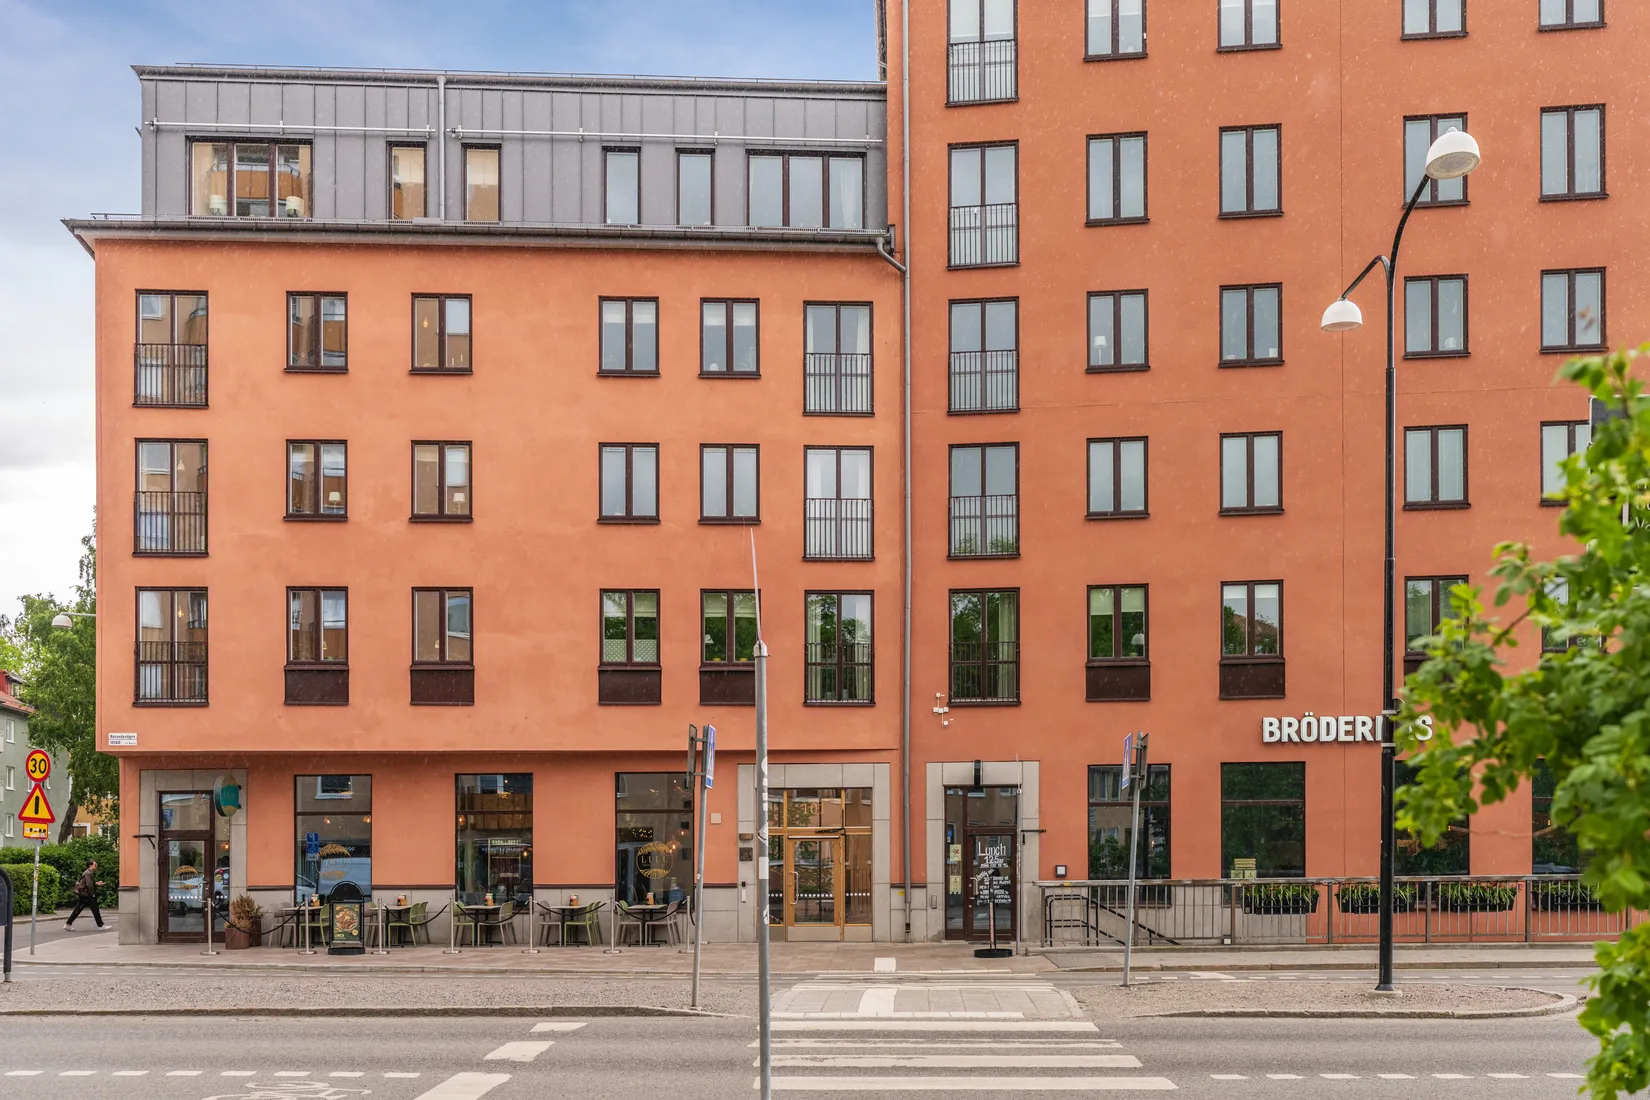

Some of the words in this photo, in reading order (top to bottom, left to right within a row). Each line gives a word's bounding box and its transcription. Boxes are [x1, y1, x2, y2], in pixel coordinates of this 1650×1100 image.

[1262, 711, 1433, 743] BRÖDERS
[30, 758, 47, 774] 30
[802, 802, 825, 815] 101
[978, 841, 1006, 856] Lunch
